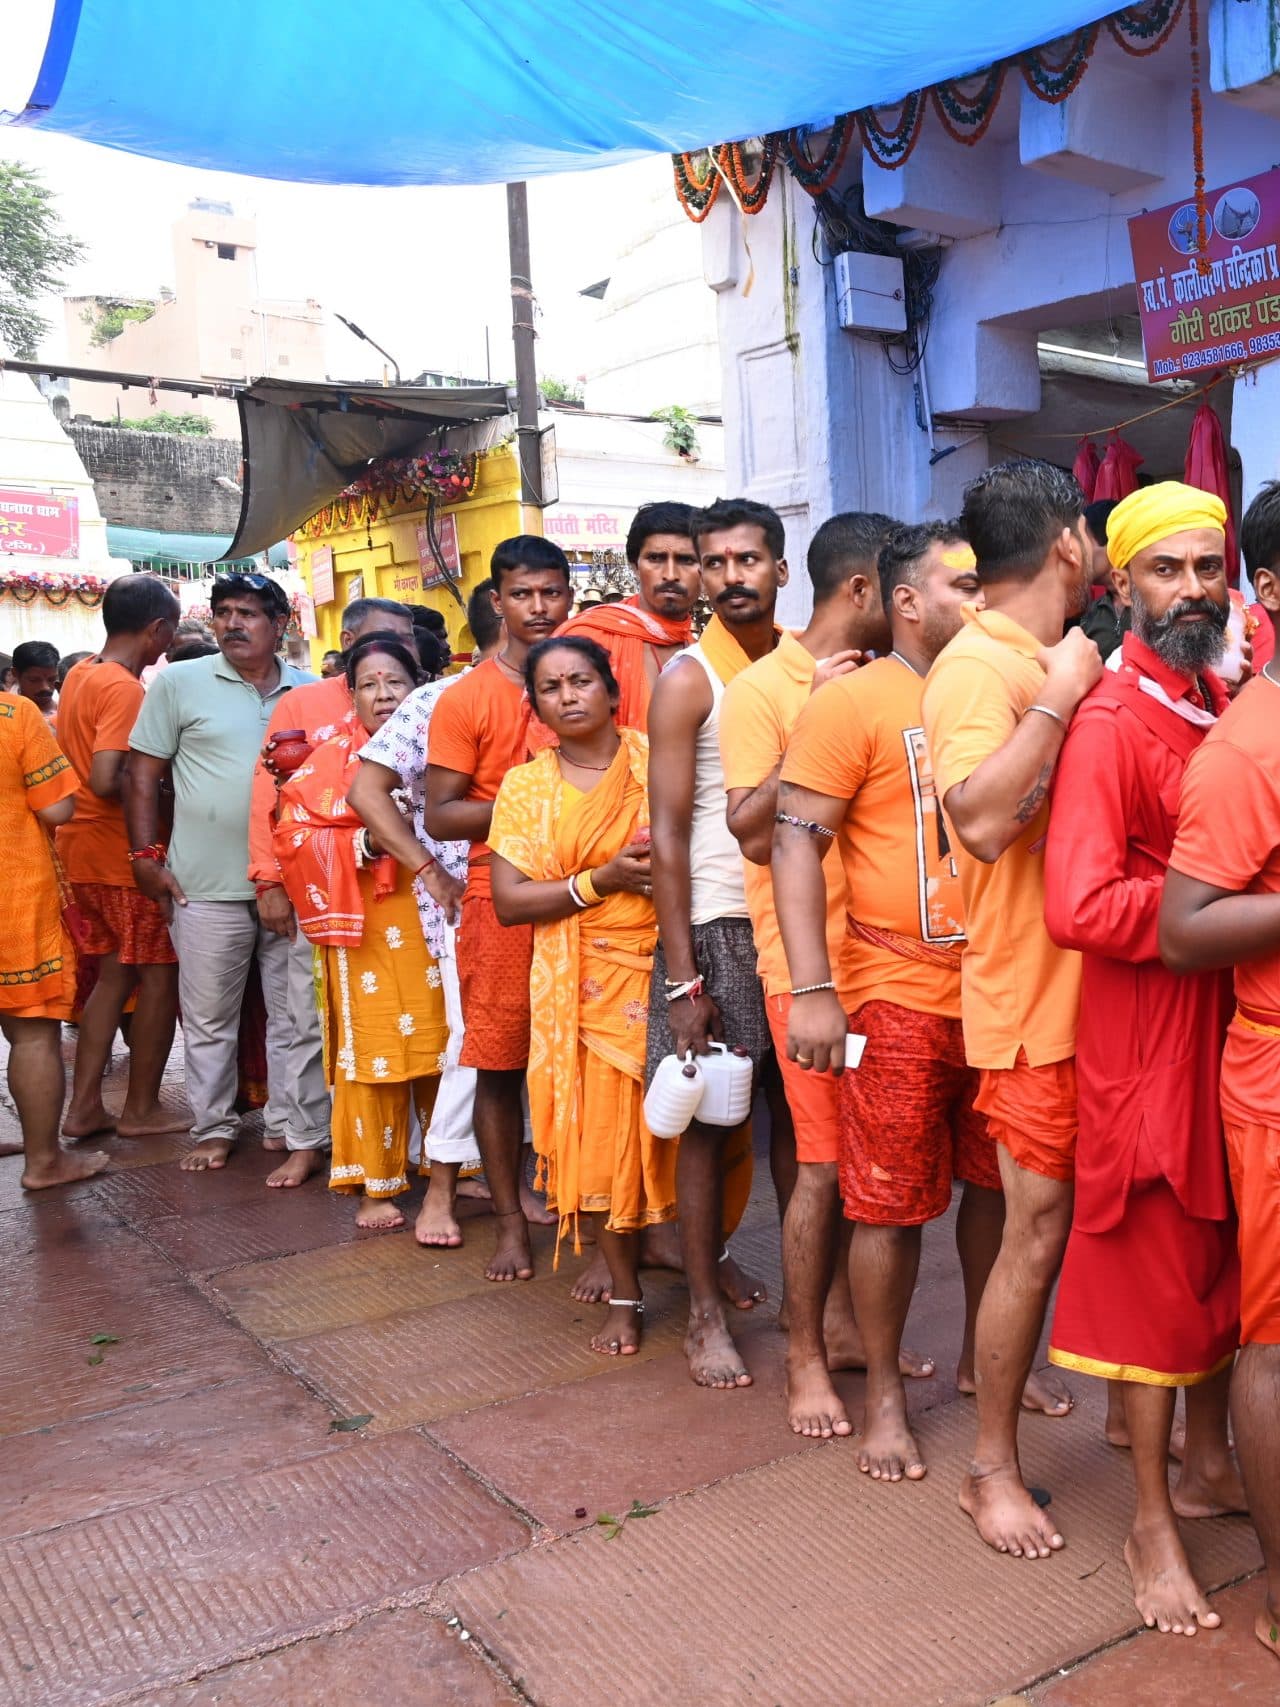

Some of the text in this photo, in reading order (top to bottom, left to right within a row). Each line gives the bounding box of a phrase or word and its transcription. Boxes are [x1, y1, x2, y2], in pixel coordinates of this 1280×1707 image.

[1169, 307, 1204, 344] गौरी
[1209, 303, 1251, 337] शंकर
[1154, 359, 1180, 376] Mob.:
[1182, 342, 1248, 369] 9234581666,
